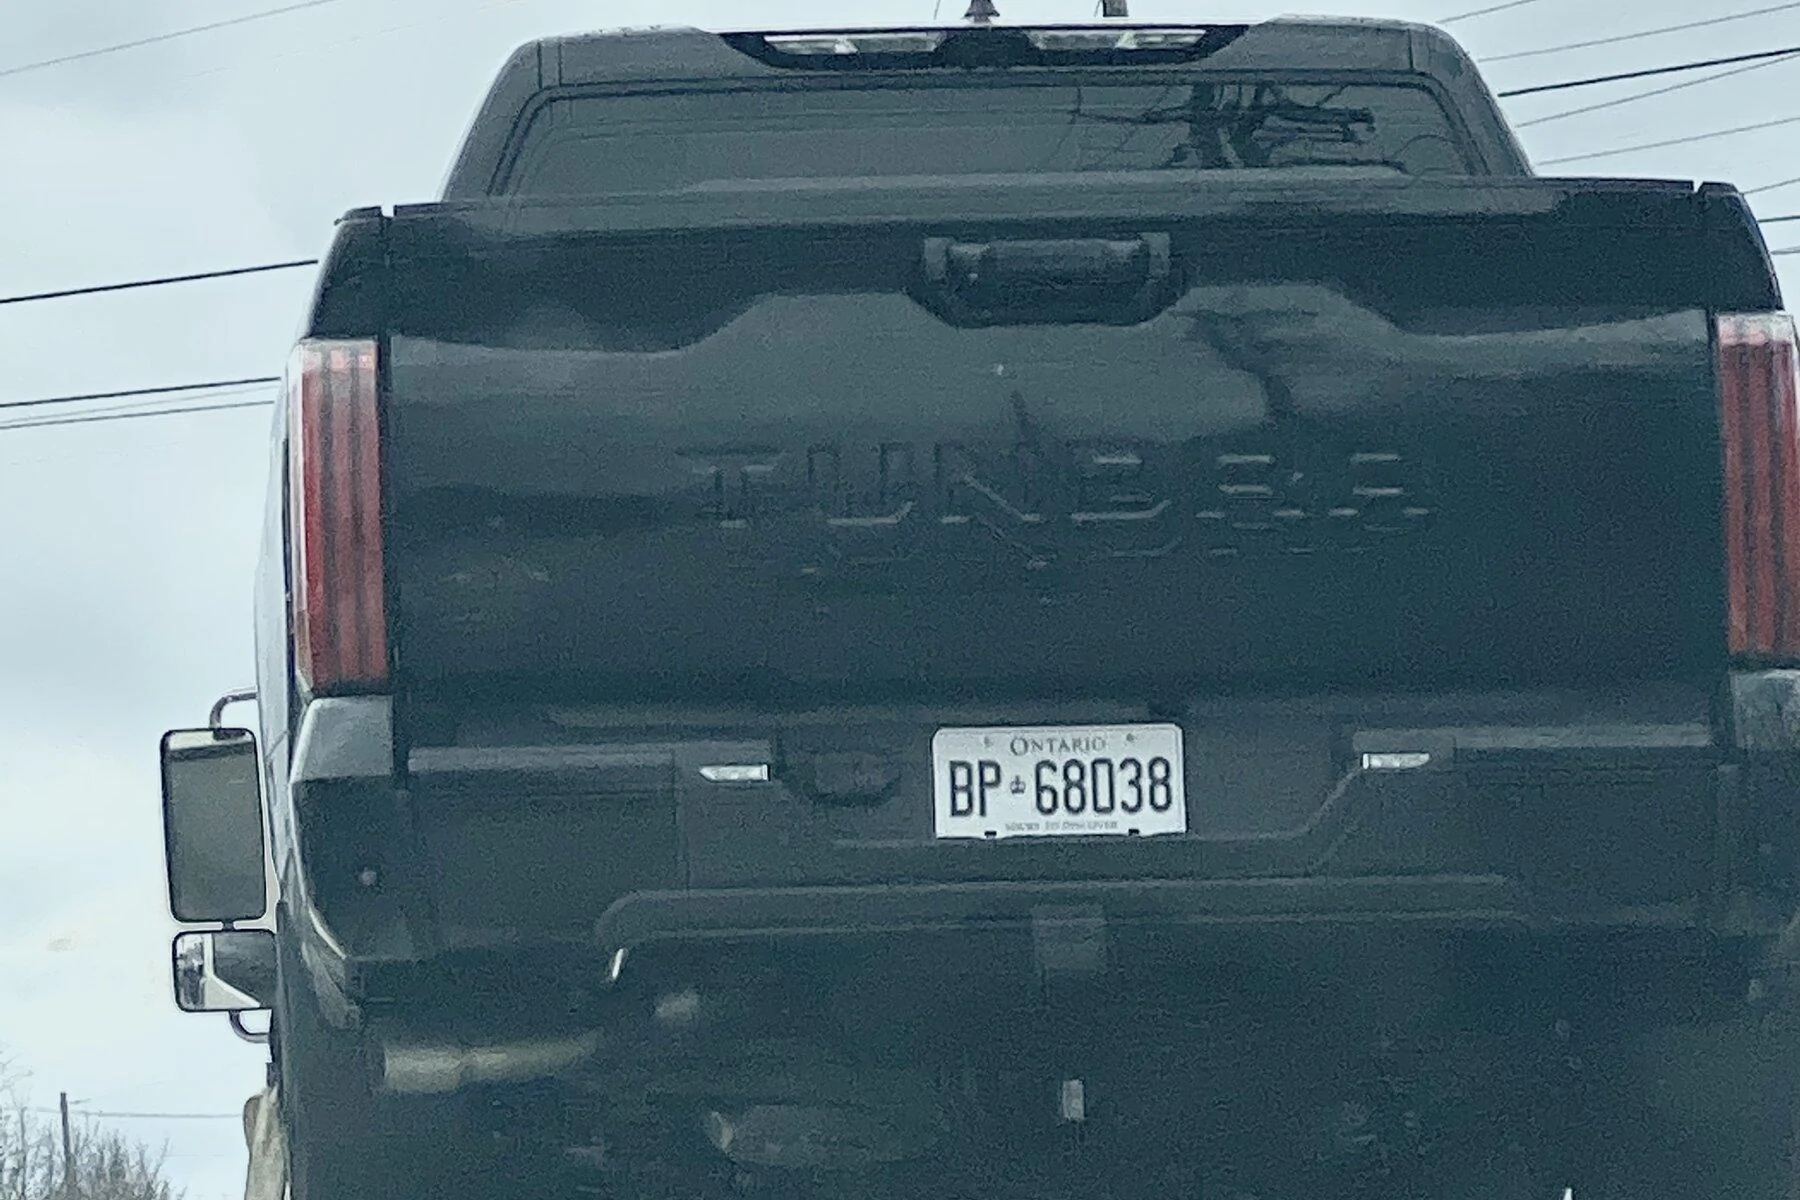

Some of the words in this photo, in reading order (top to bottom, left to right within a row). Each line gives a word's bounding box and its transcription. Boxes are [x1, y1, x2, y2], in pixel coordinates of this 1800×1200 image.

[1010, 737, 1107, 756] ONTARIO
[949, 760, 1001, 817] BP
[1035, 757, 1172, 815] 68038
